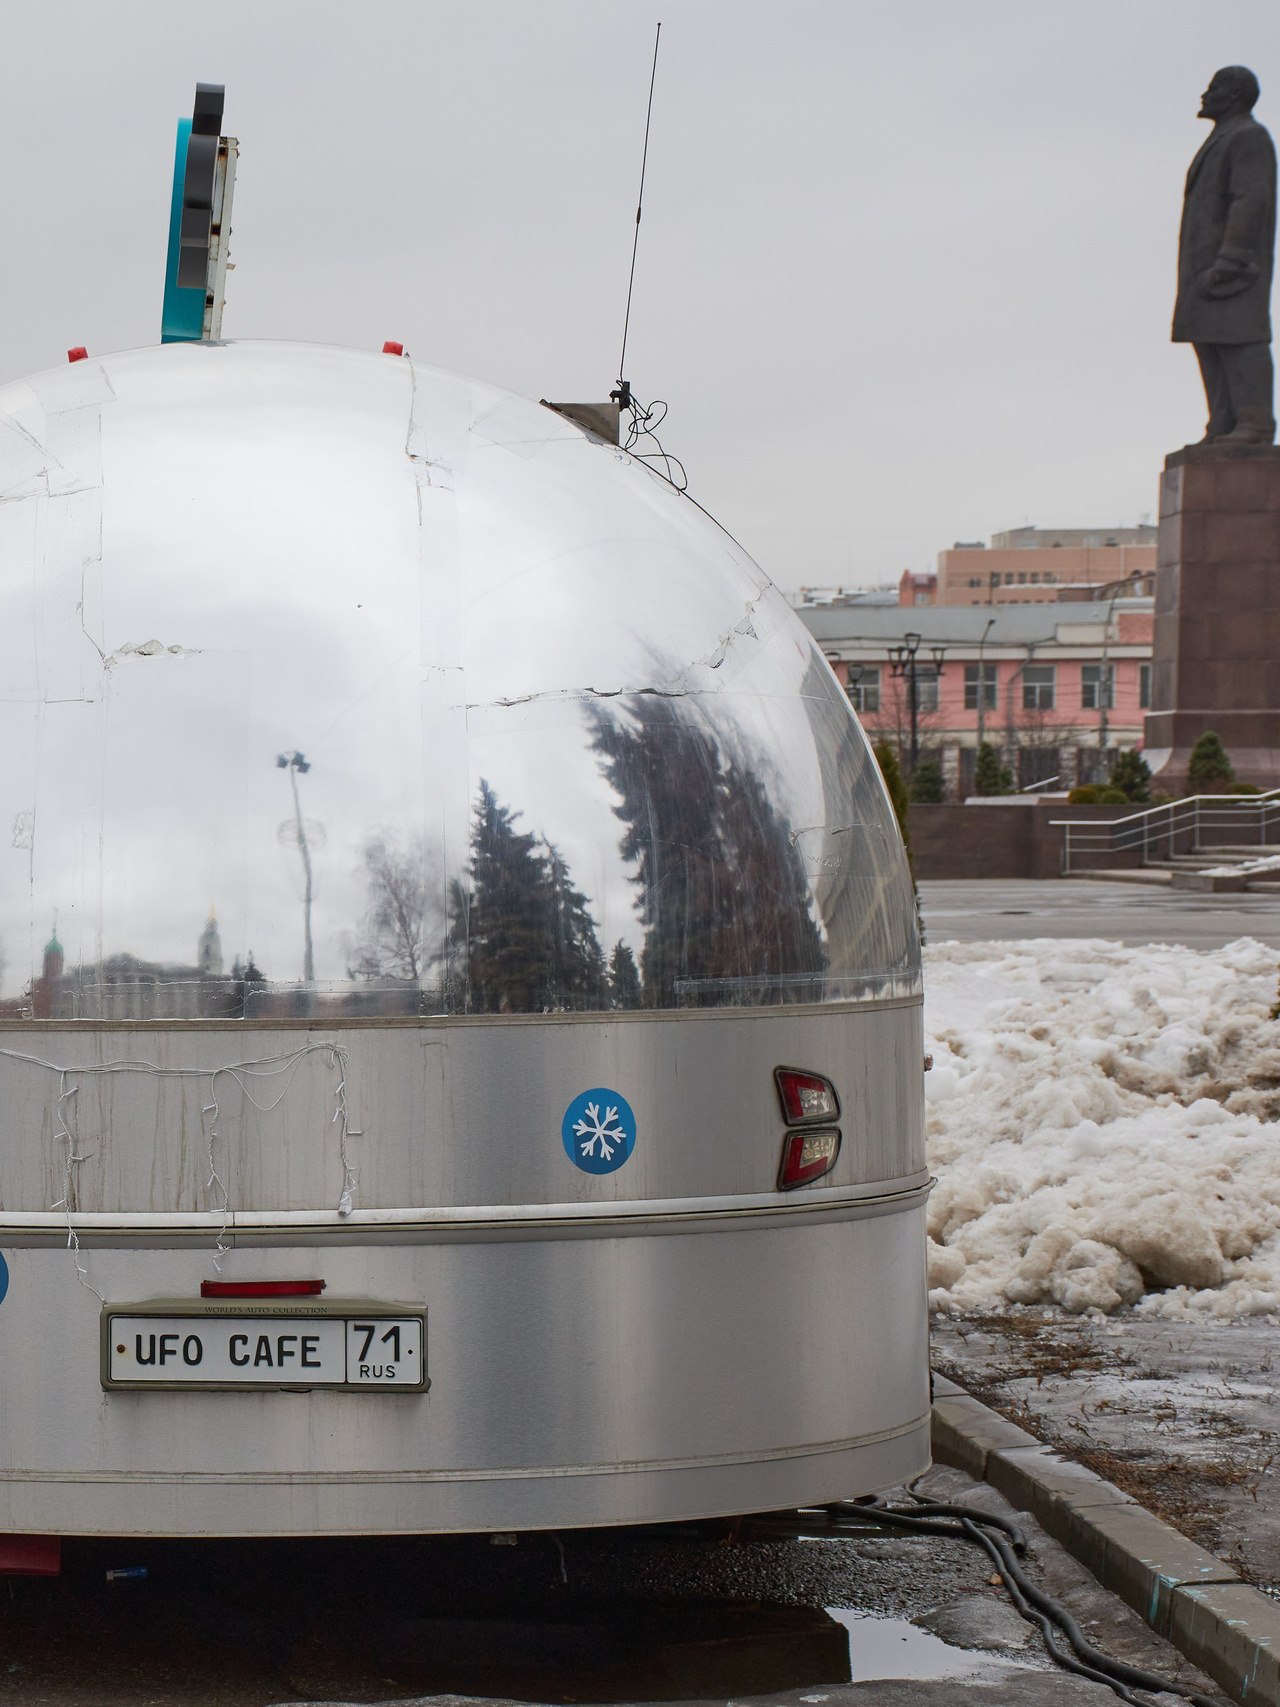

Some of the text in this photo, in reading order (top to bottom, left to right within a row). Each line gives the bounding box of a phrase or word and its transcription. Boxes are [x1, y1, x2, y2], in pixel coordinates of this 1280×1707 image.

[204, 1306, 328, 1315] WORLD'S AUTO COLLECTION
[135, 1333, 322, 1368] UFO CAFE
[352, 1324, 401, 1362] 71
[359, 1364, 396, 1378] RUS
